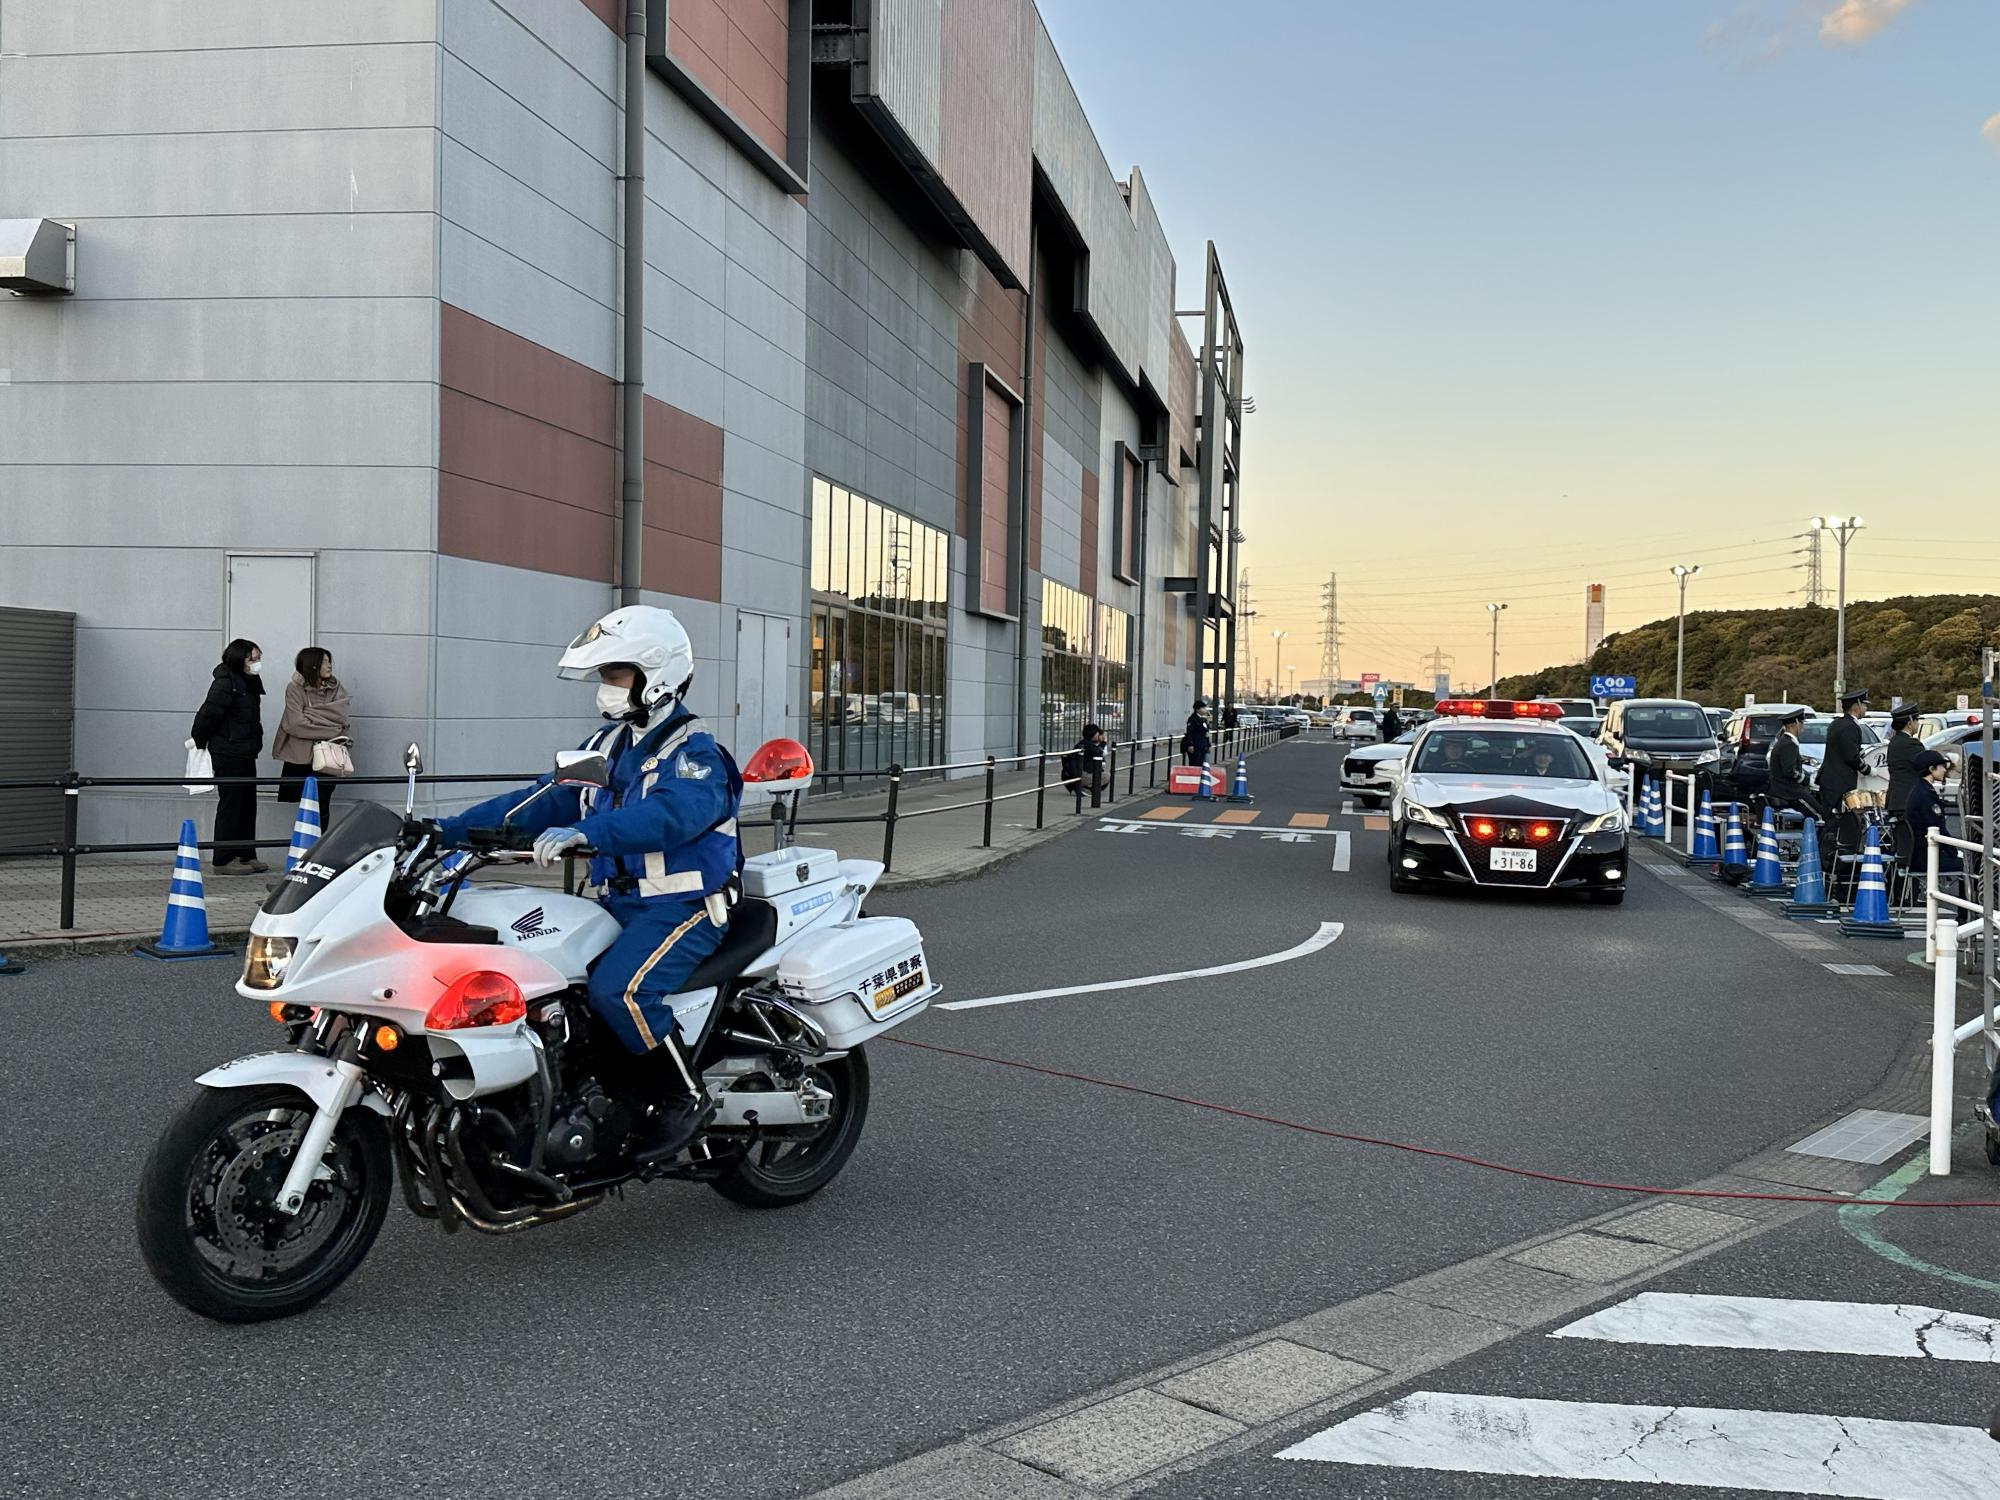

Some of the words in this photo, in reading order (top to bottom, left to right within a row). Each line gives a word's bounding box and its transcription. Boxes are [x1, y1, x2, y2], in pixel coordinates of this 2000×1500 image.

[1376, 687, 1386, 697] A
[1500, 857, 1534, 870] 31-86
[517, 926, 561, 941] HONDA
[858, 953, 922, 995] 千葉県警察
